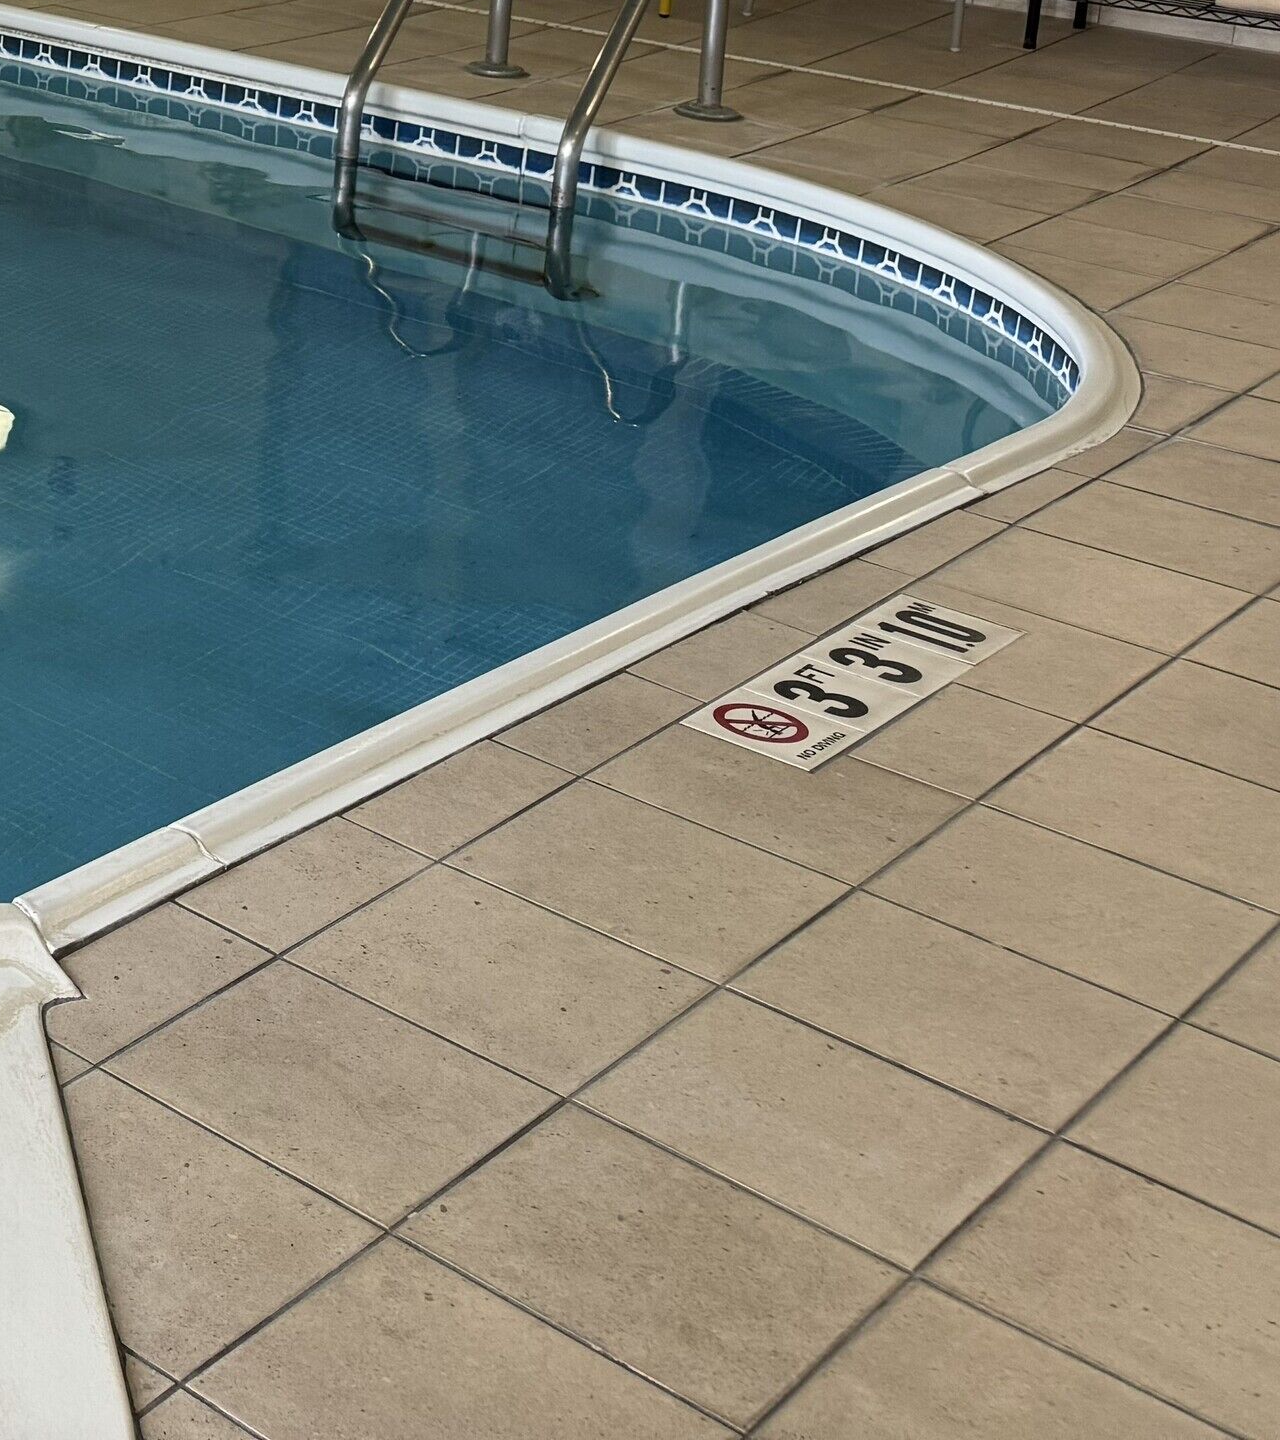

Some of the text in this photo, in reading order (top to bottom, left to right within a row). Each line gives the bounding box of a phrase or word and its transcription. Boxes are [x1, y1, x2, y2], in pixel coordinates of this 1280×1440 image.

[907, 602, 937, 614] M
[848, 632, 892, 651] IN
[793, 663, 835, 684] FT
[828, 647, 923, 684] 3
[773, 679, 870, 718] 3
[796, 731, 847, 761] NO DIVING
